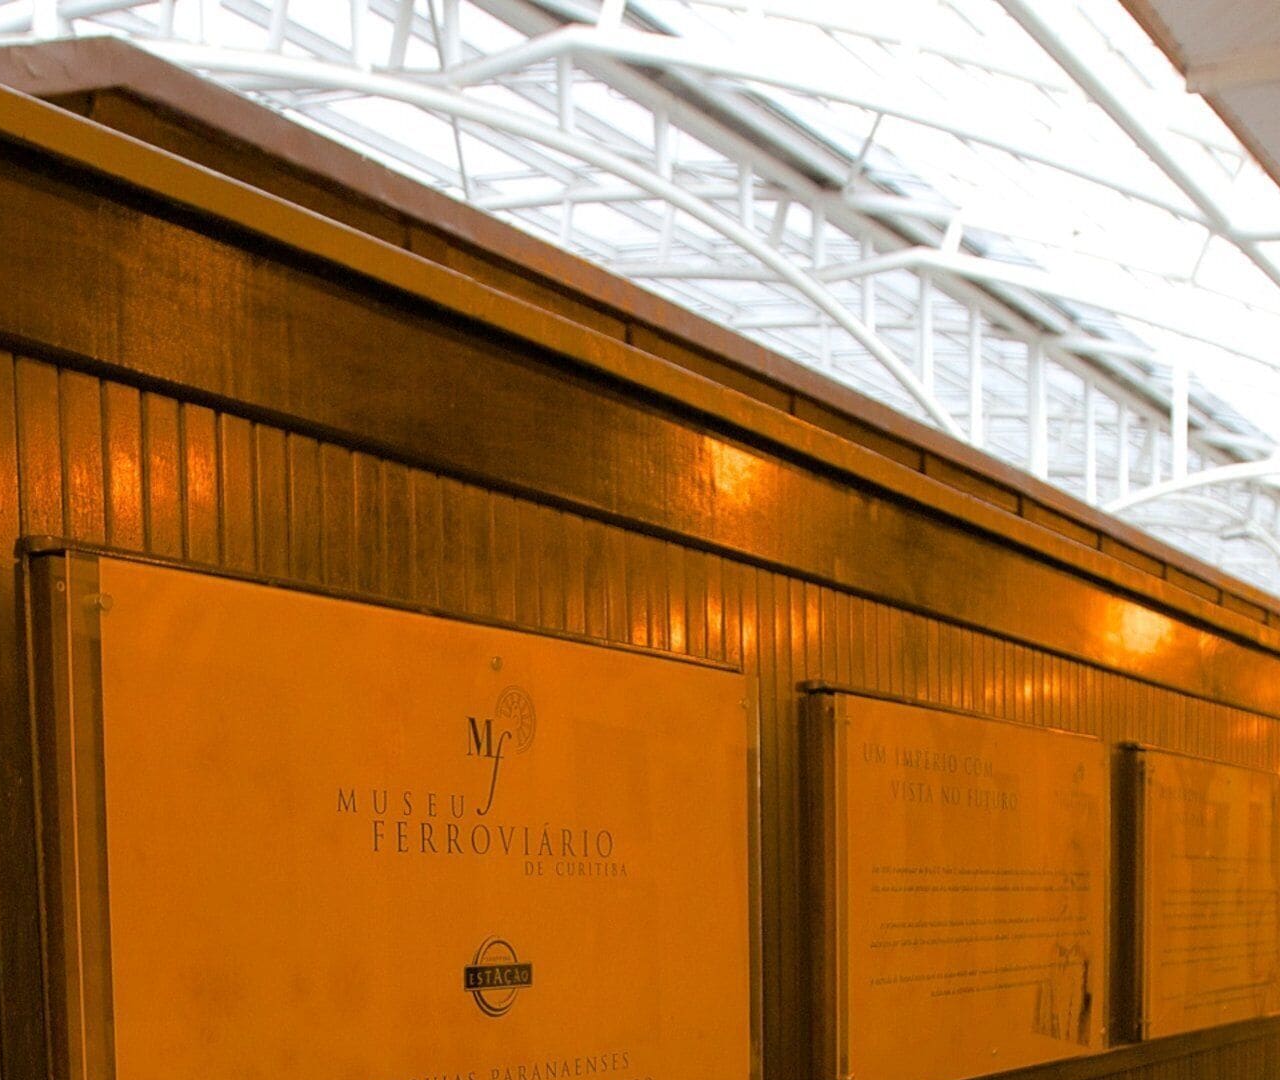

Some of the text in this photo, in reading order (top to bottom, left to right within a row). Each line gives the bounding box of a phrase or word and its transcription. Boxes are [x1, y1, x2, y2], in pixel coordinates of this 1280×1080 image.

[862, 742, 887, 763] UM
[337, 788, 465, 819] MUSEU
[890, 779, 1018, 811] VISTA NO FUTURO
[373, 820, 613, 858] FERROVIÁRIO
[524, 861, 627, 877] DE CURITIBA
